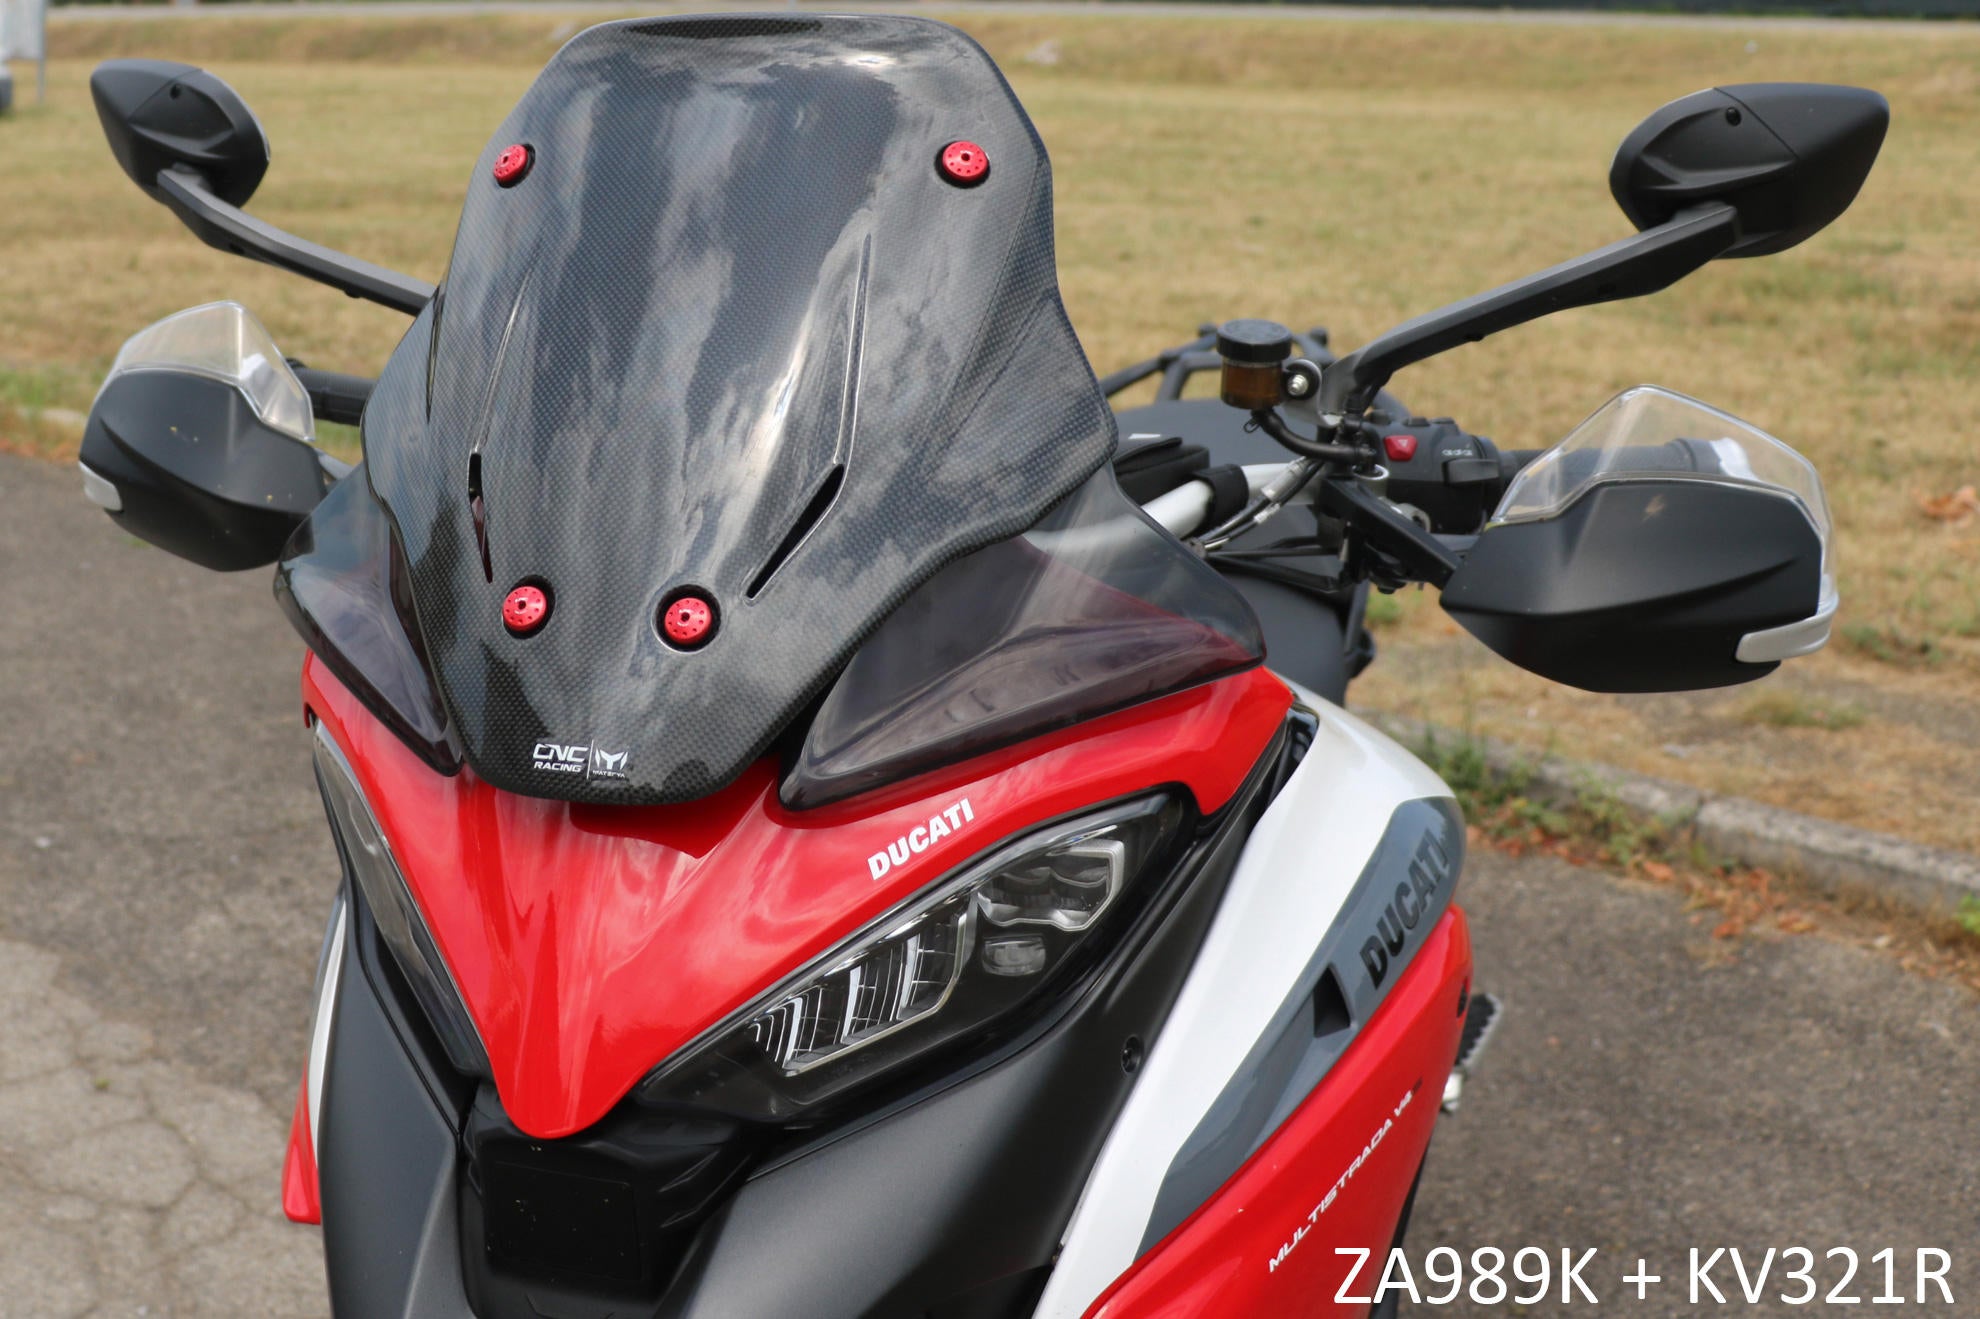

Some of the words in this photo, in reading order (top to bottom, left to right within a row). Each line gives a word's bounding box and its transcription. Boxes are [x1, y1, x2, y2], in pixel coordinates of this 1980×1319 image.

[532, 743, 589, 763] CNC
[533, 761, 582, 773] RACING
[867, 798, 975, 881] DUCATI
[1359, 829, 1450, 991] DUCATI
[1269, 1118, 1393, 1273] MULTISTRADA
